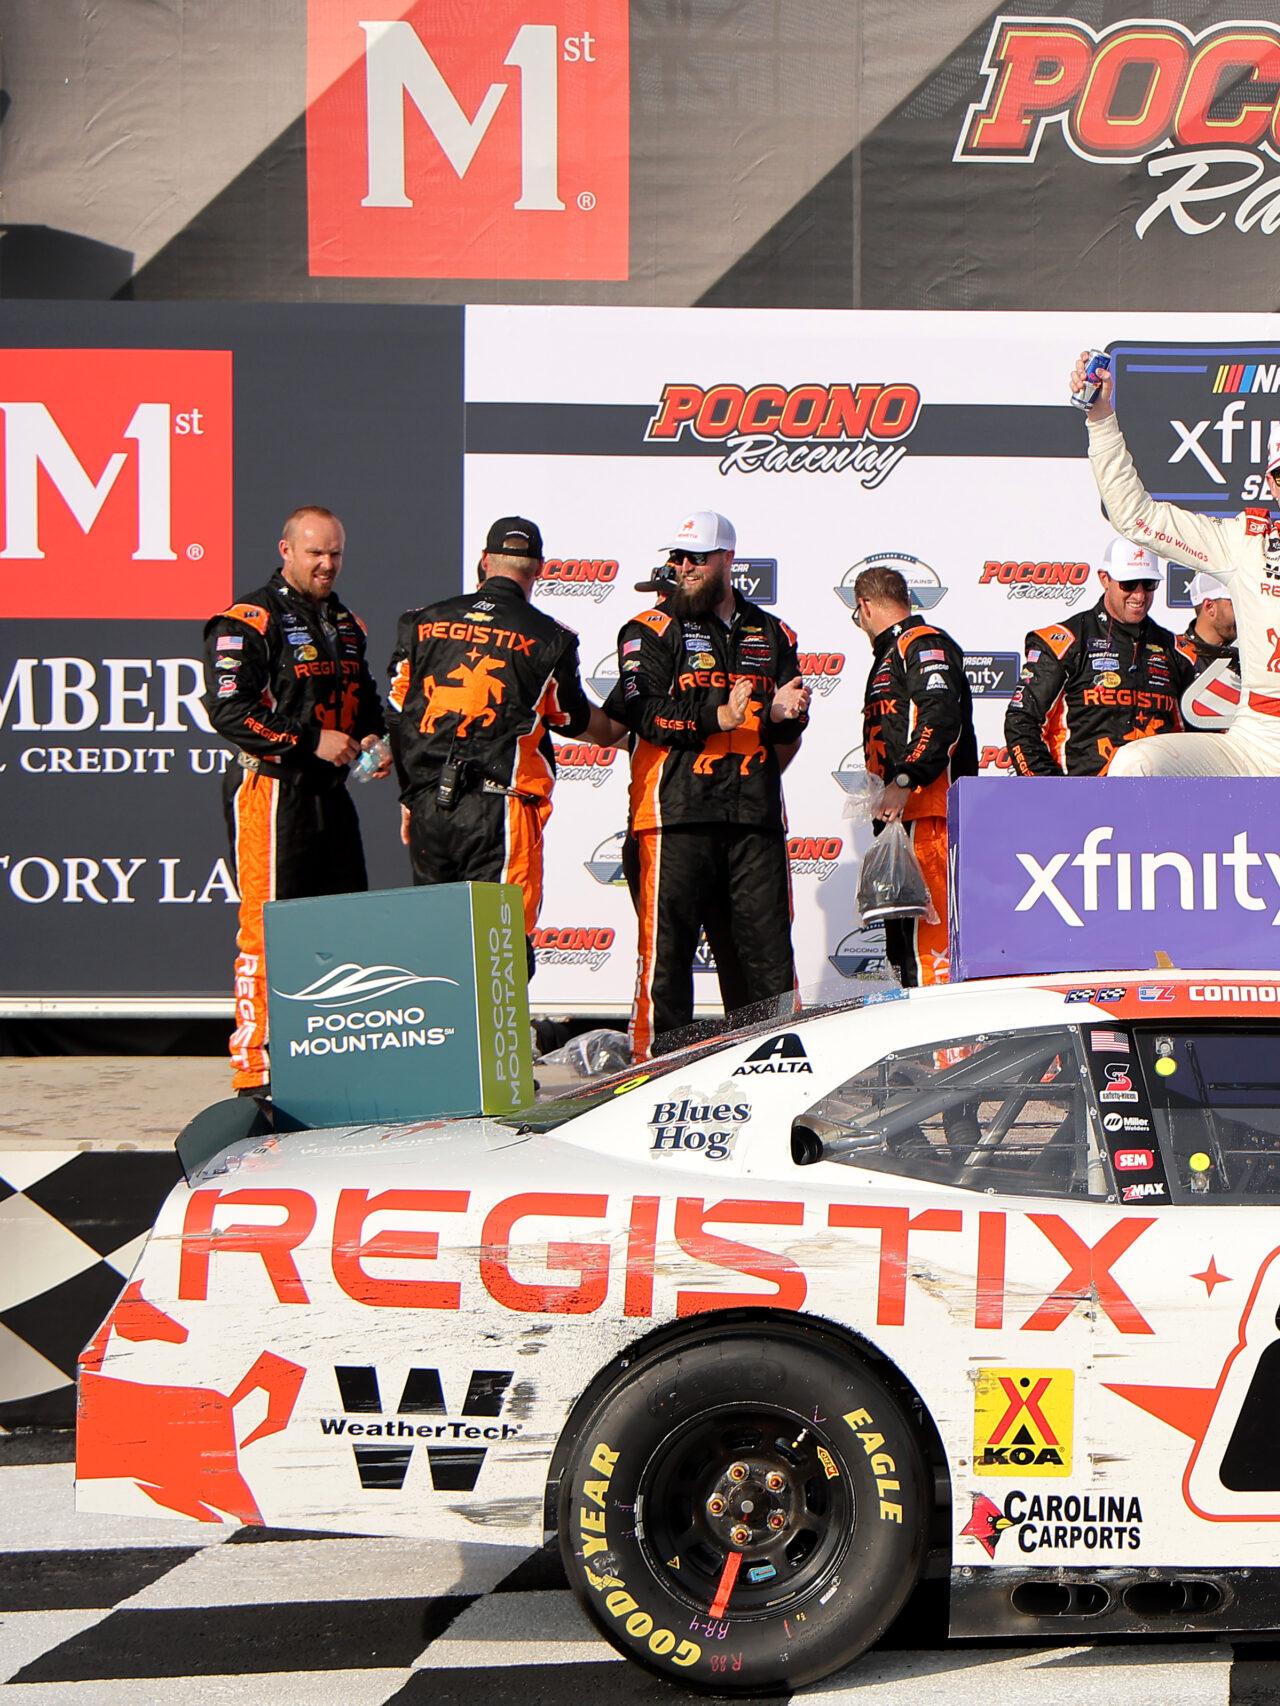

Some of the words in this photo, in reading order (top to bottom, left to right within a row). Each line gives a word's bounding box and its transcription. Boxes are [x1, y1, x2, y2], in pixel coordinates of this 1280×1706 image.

[644, 383, 922, 442] POCONO
[719, 432, 908, 490] Raceway
[541, 560, 619, 582] CONO
[979, 561, 1090, 585] POCONO
[535, 579, 615, 604] Raceway
[1007, 581, 1090, 606] Raceway
[418, 621, 536, 656] REGISTIX
[20, 747, 189, 775] CREDIT
[488, 927, 507, 1081] POCONO
[307, 1007, 425, 1034] POCONO
[731, 1059, 813, 1076] AXALTA
[650, 1098, 751, 1126] Blues
[1123, 1117, 1149, 1127] Miller
[650, 1124, 732, 1160] Hog
[1119, 1154, 1148, 1167] SEM
[178, 1188, 1159, 1334] REGISTIX
[320, 1418, 518, 1441] WeatherTech
[842, 1407, 903, 1525] EAGLE
[983, 1447, 1064, 1466] KOA
[1003, 1490, 1143, 1525] CAROLINA
[1018, 1523, 1142, 1553] CARPORTS
